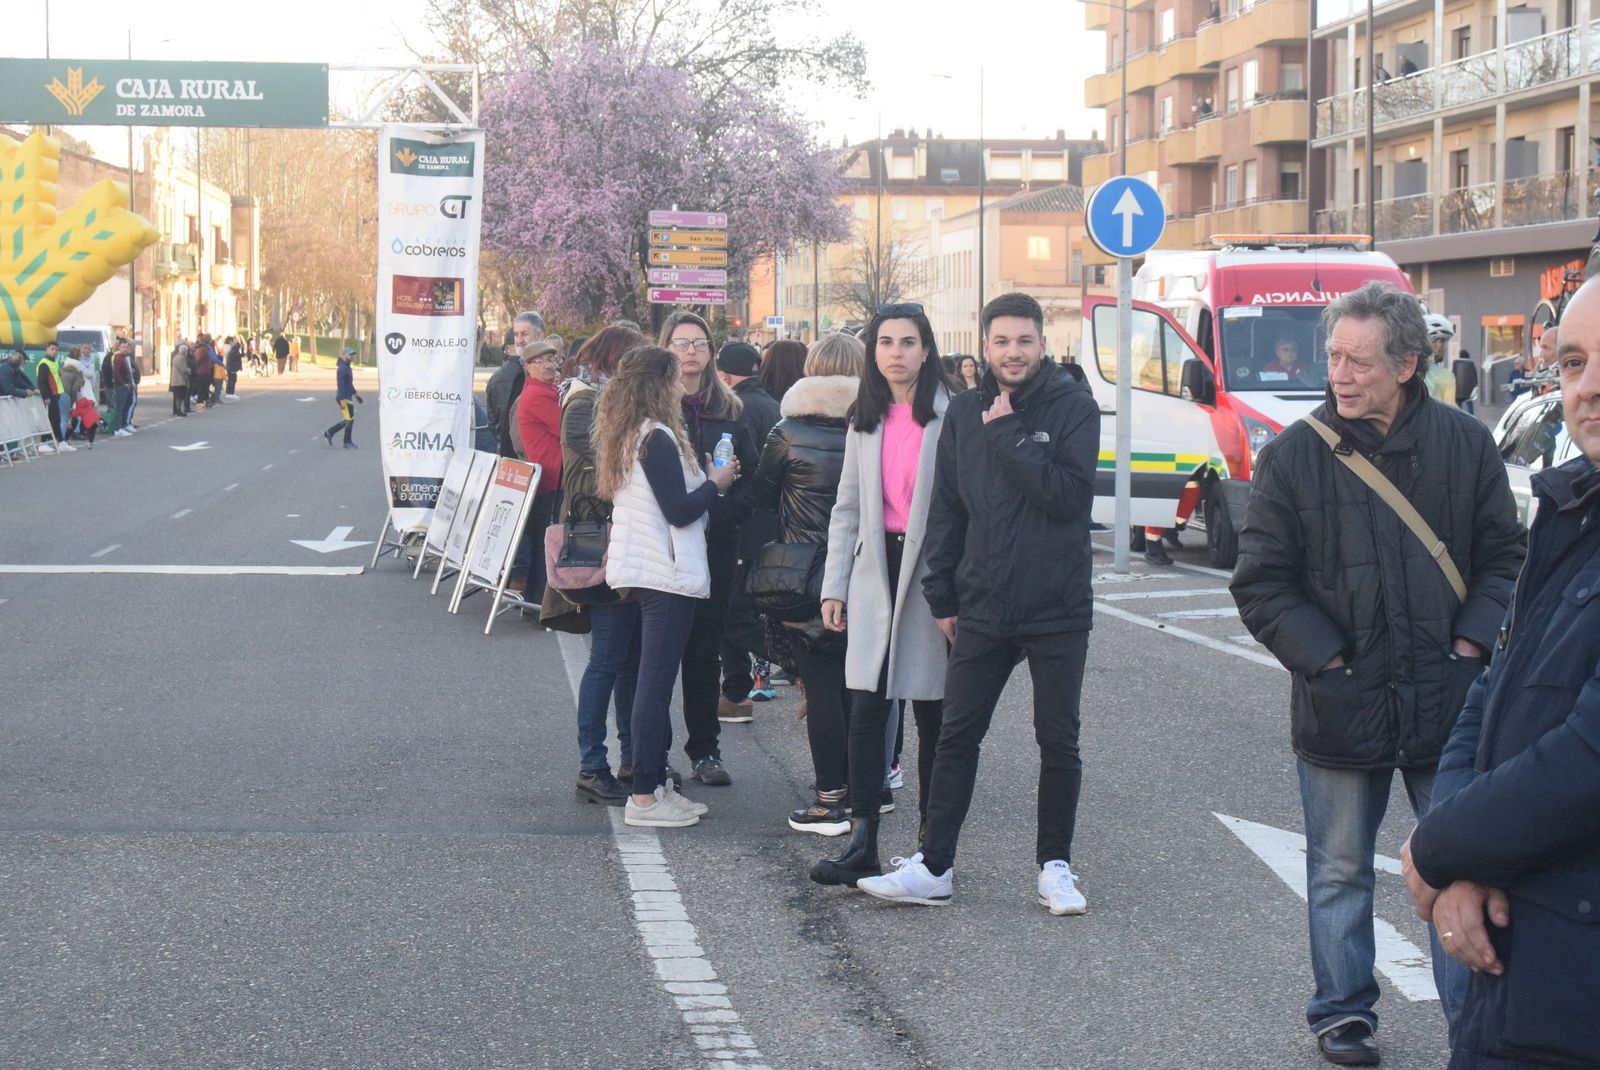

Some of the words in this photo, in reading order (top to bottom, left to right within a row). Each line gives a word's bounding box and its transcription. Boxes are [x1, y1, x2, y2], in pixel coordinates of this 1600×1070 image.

[115, 77, 175, 100] CAJA
[180, 79, 264, 100] RURAL
[116, 104, 136, 116] DE
[140, 105, 206, 117] ZAMORA
[418, 155, 438, 164] CAJA
[440, 156, 470, 165] RURAL
[404, 244, 466, 258] cobreros
[411, 338, 468, 348] MORALEJO
[392, 432, 455, 452] ARIMA
[408, 492, 438, 502] zamo
